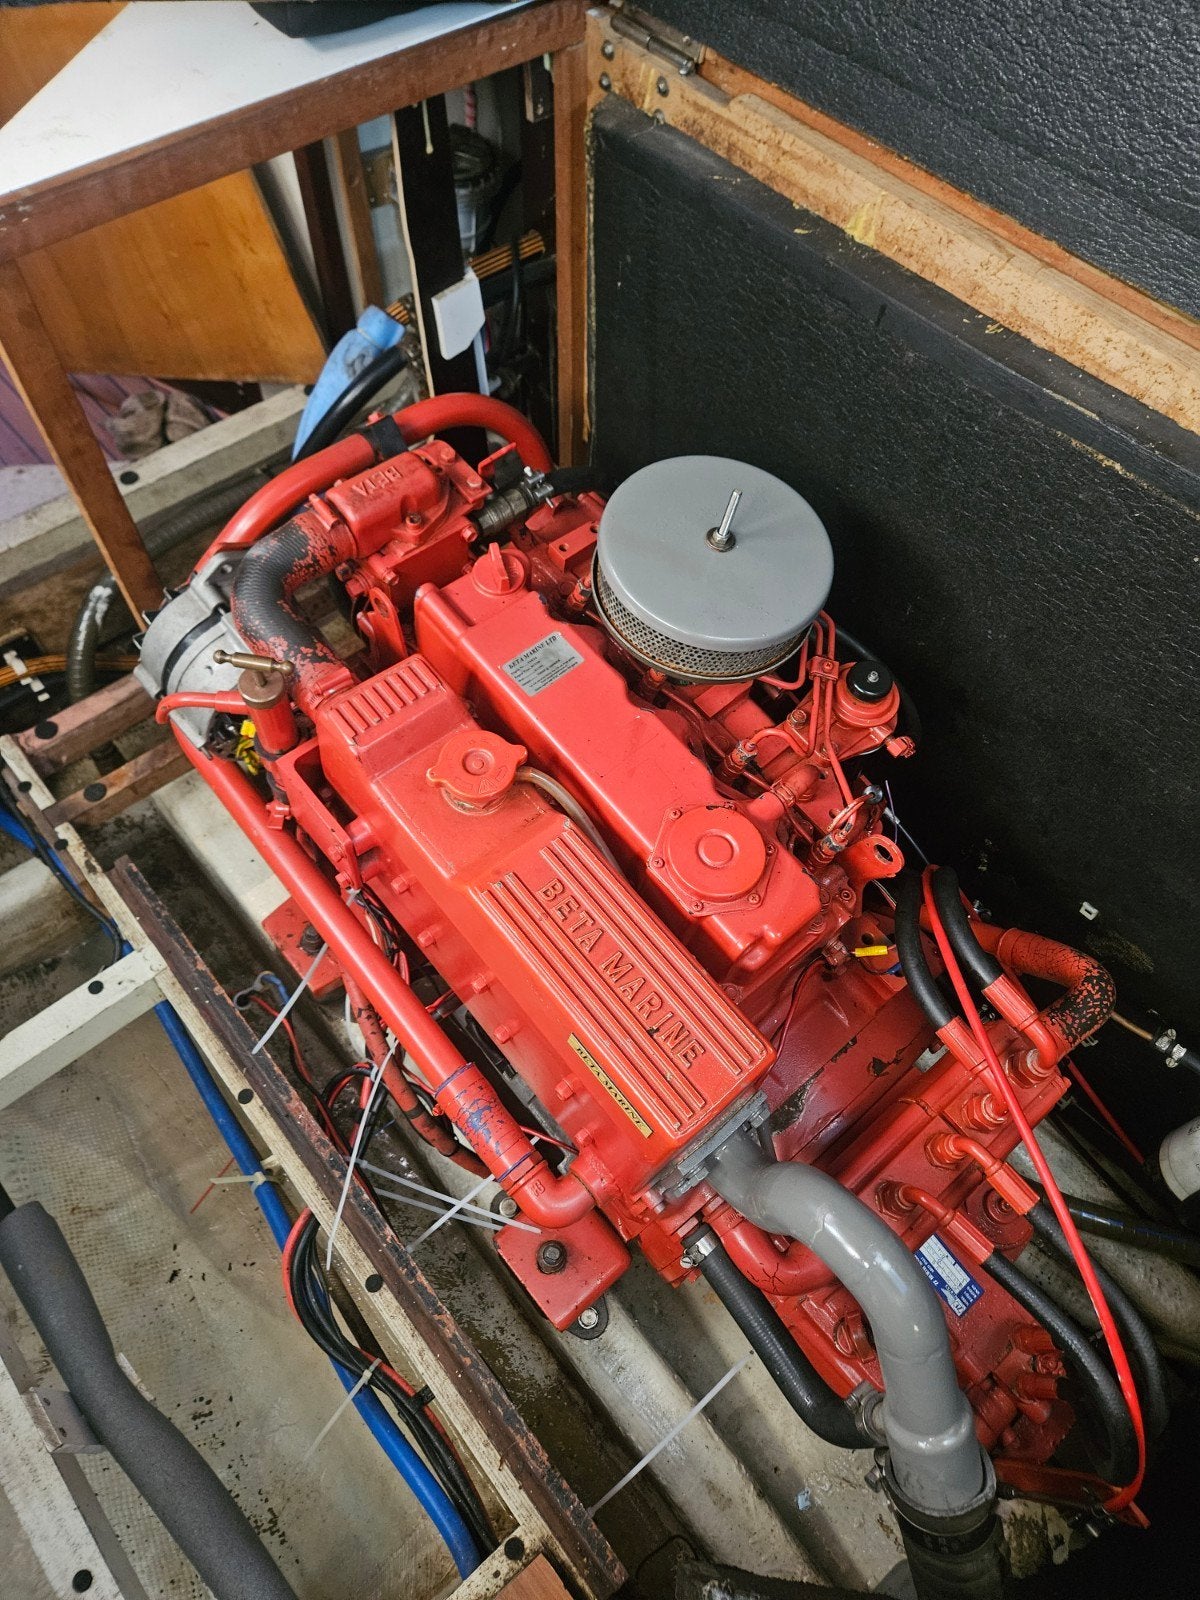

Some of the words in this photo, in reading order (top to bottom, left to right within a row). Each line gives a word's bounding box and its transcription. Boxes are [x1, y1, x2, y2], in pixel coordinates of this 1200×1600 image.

[351, 465, 404, 497] BETA
[545, 634, 557, 646] LTD
[537, 877, 605, 954] BETA
[600, 950, 706, 1070] MARINE
[576, 1047, 601, 1077] BETA
[602, 1080, 642, 1126] MARINE
